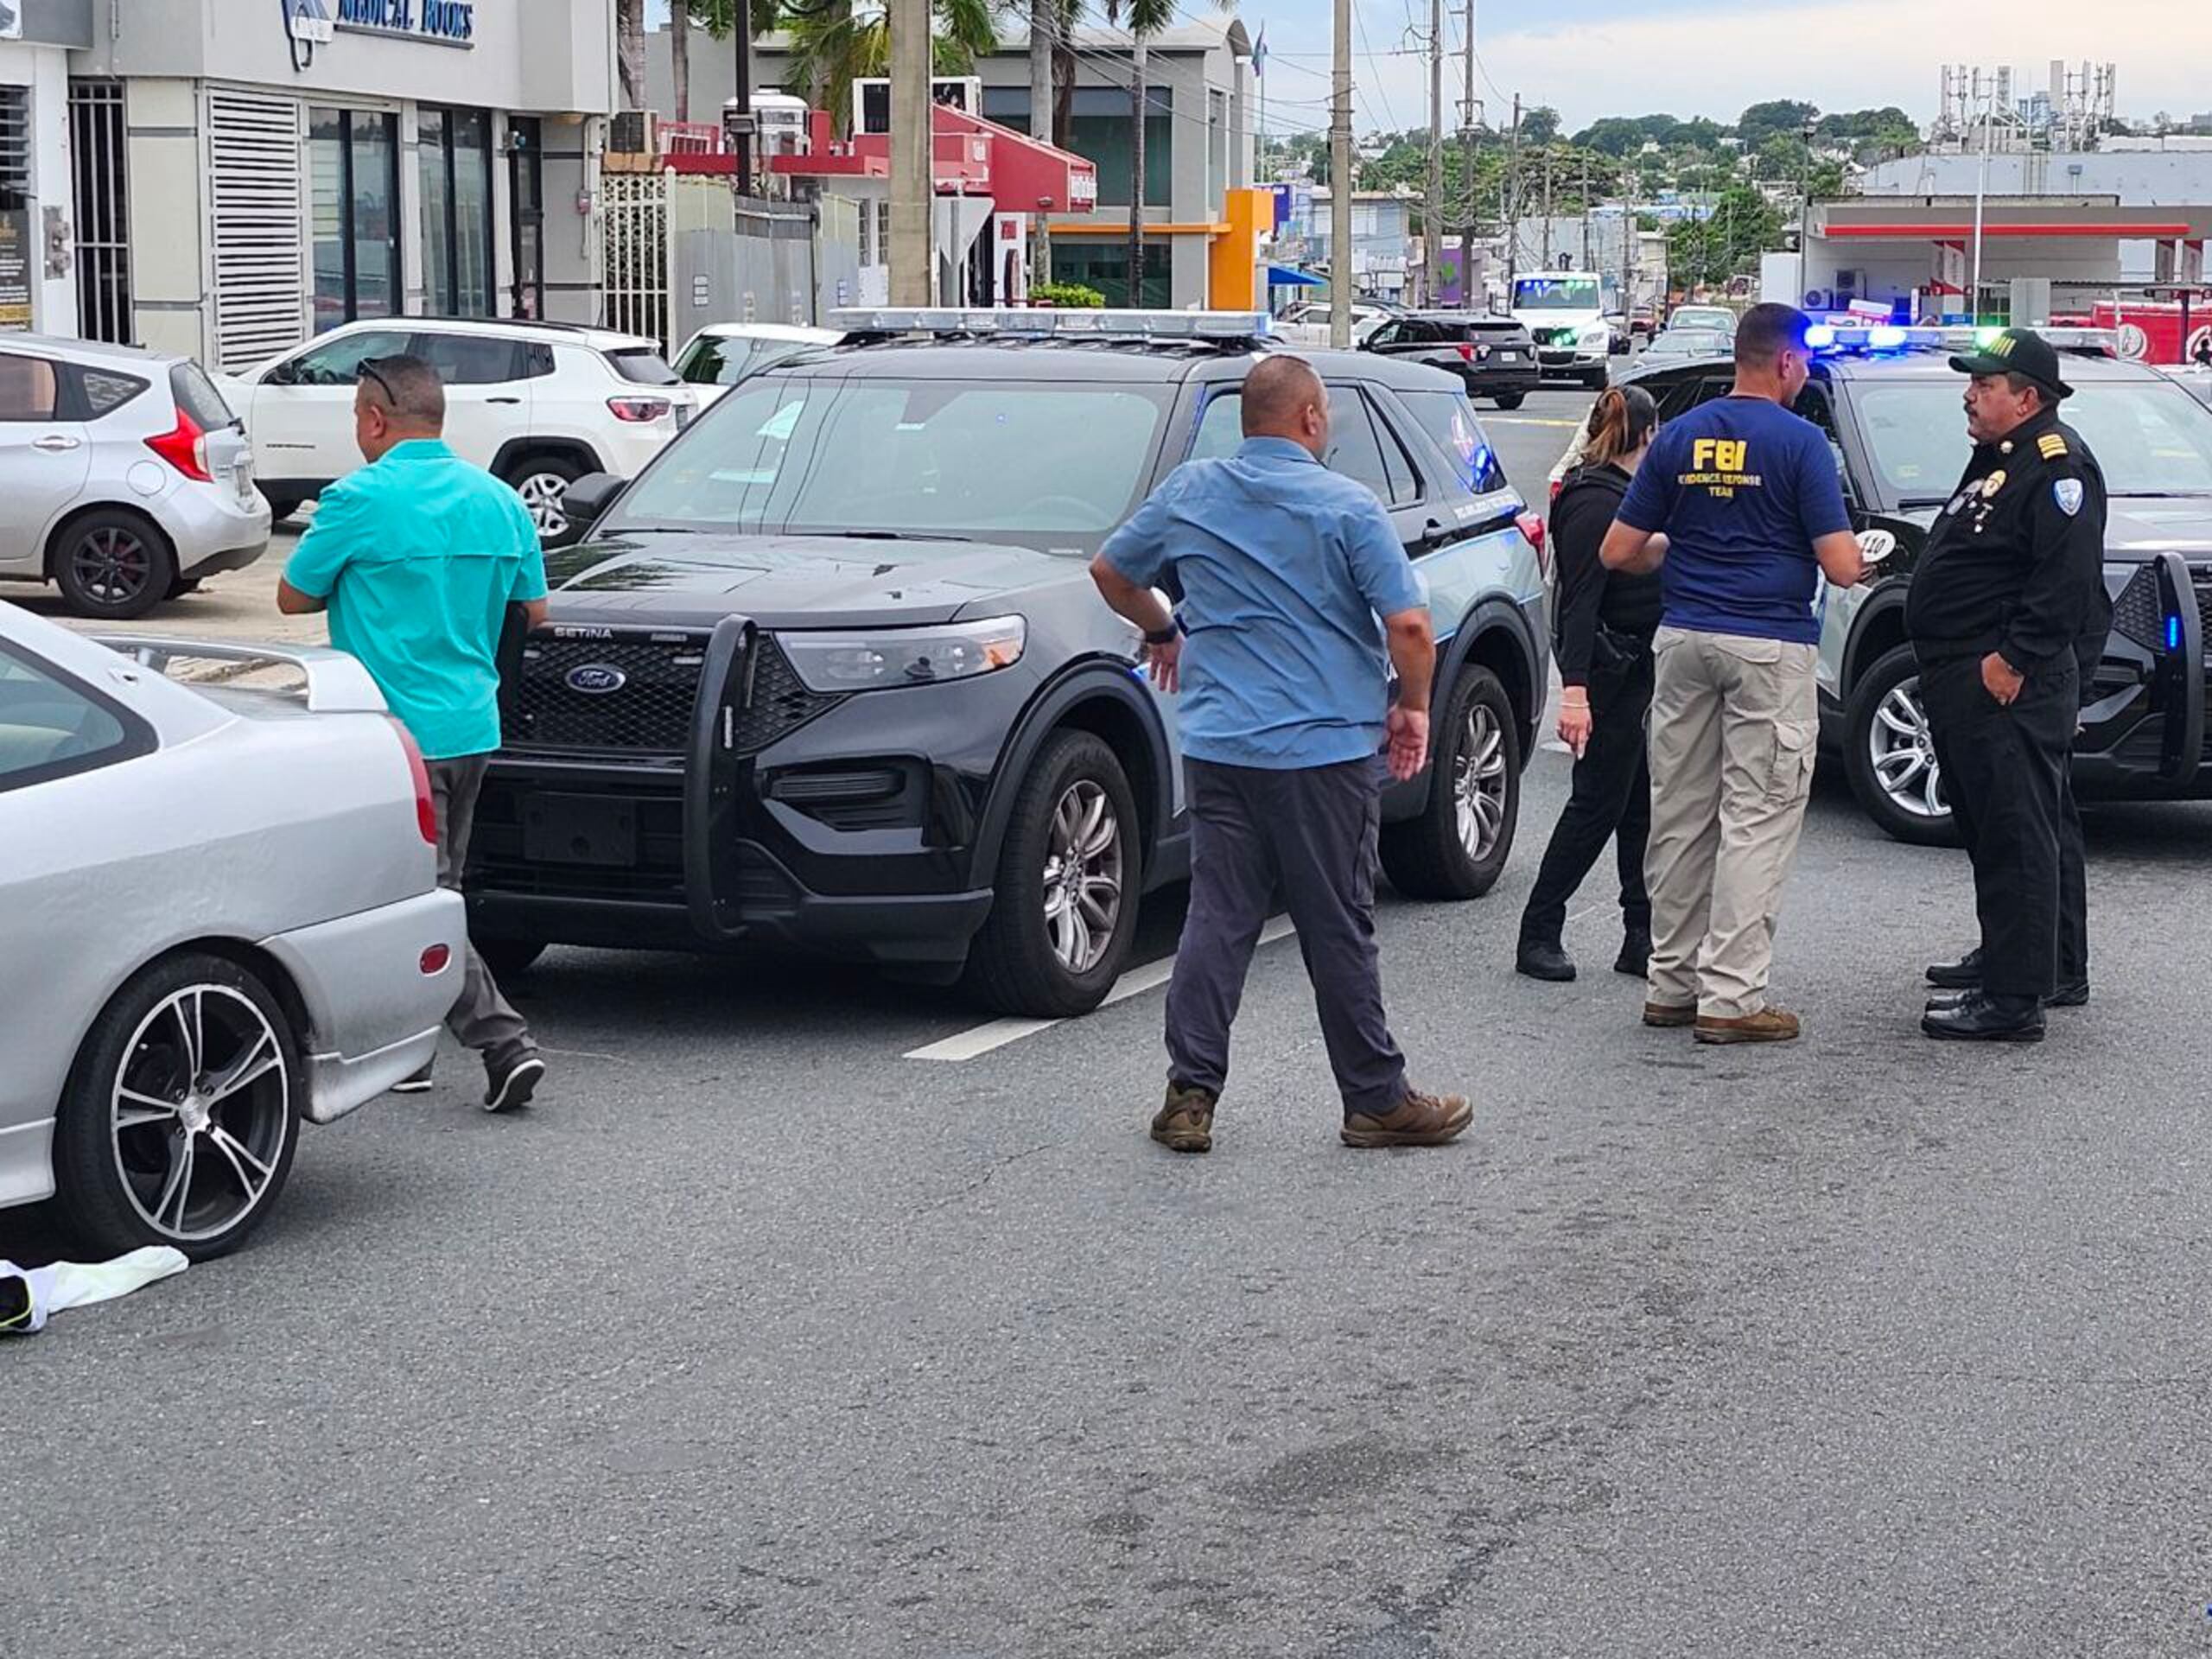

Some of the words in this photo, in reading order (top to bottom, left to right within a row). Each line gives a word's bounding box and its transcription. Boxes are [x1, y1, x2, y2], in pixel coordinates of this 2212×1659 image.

[1694, 439, 1747, 471] FBI
[554, 626, 613, 639] SETINA
[577, 671, 610, 687] Ford
